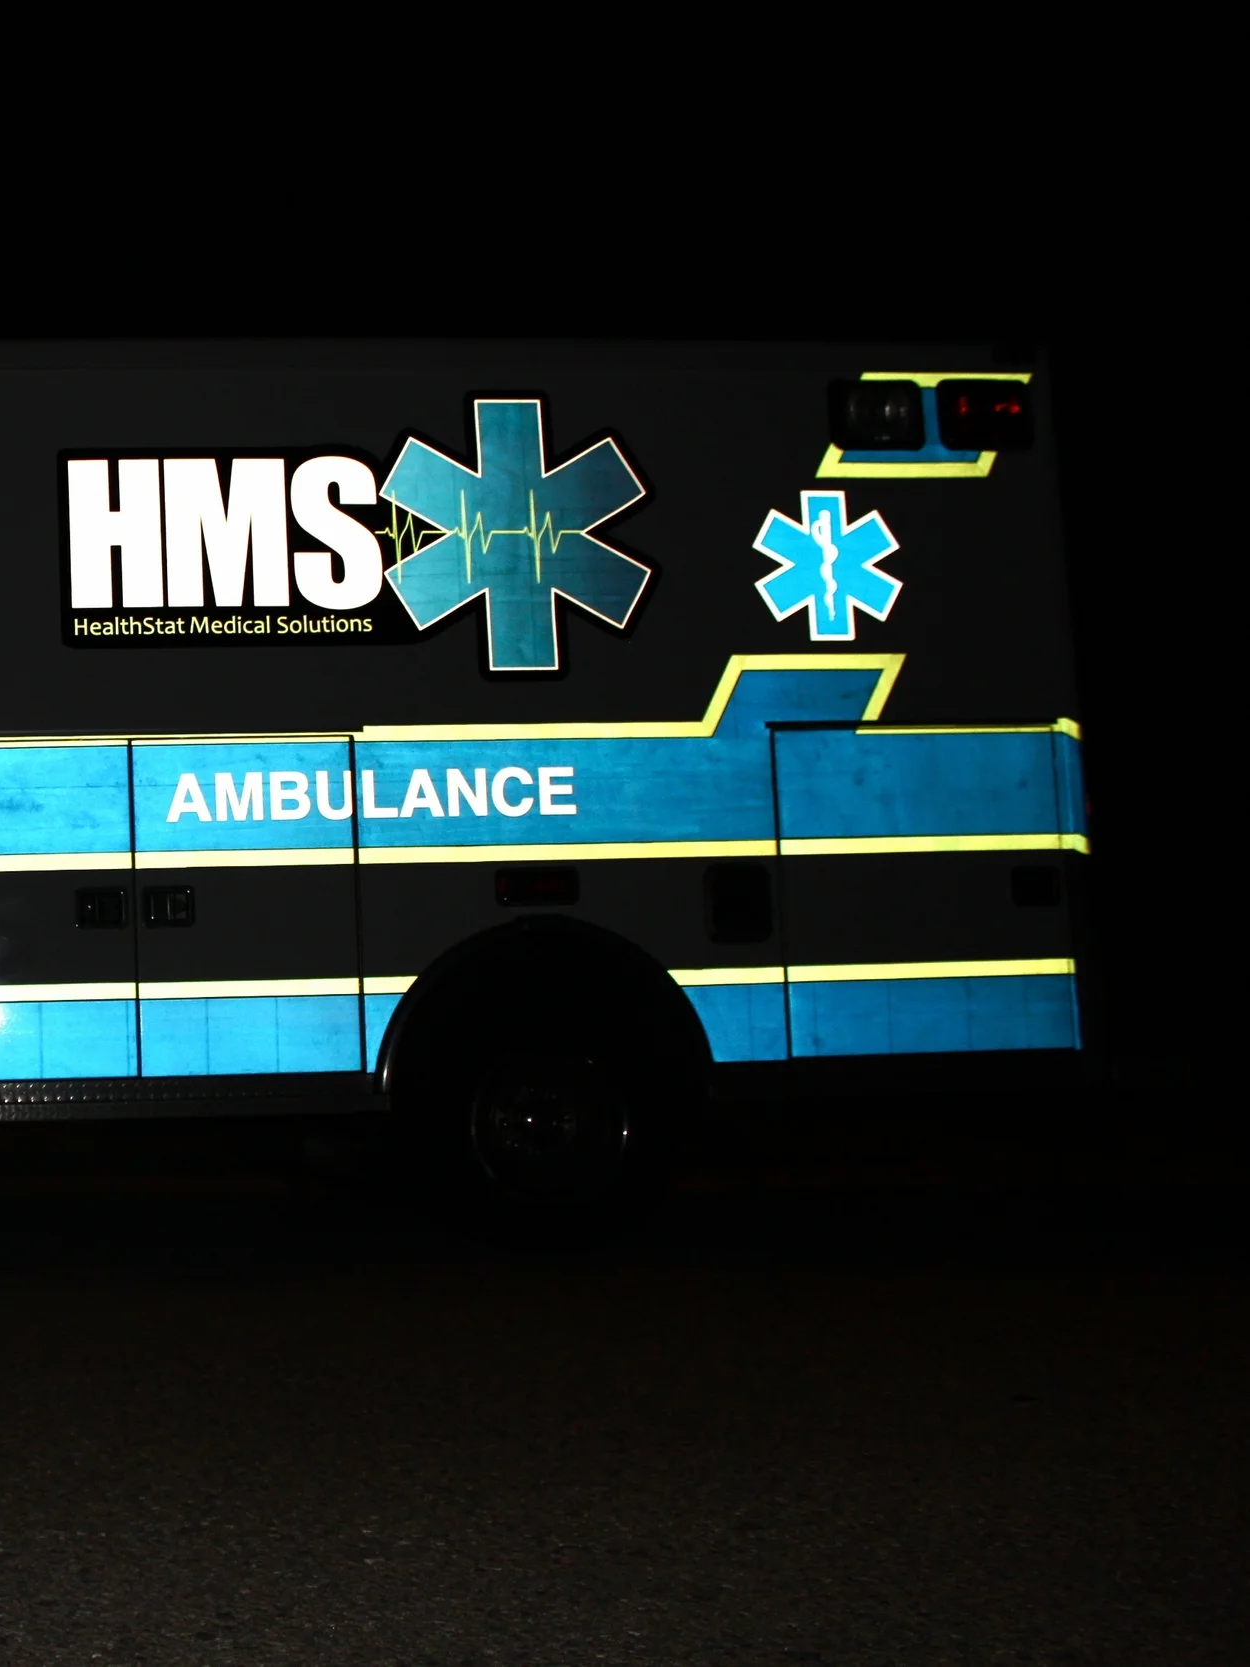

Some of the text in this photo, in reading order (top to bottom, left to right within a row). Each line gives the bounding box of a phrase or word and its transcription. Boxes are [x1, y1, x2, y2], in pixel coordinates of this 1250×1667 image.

[67, 455, 383, 611] HMS
[73, 614, 373, 636] HealthStat Medical Solutions
[166, 766, 577, 823] AMBULANCE
